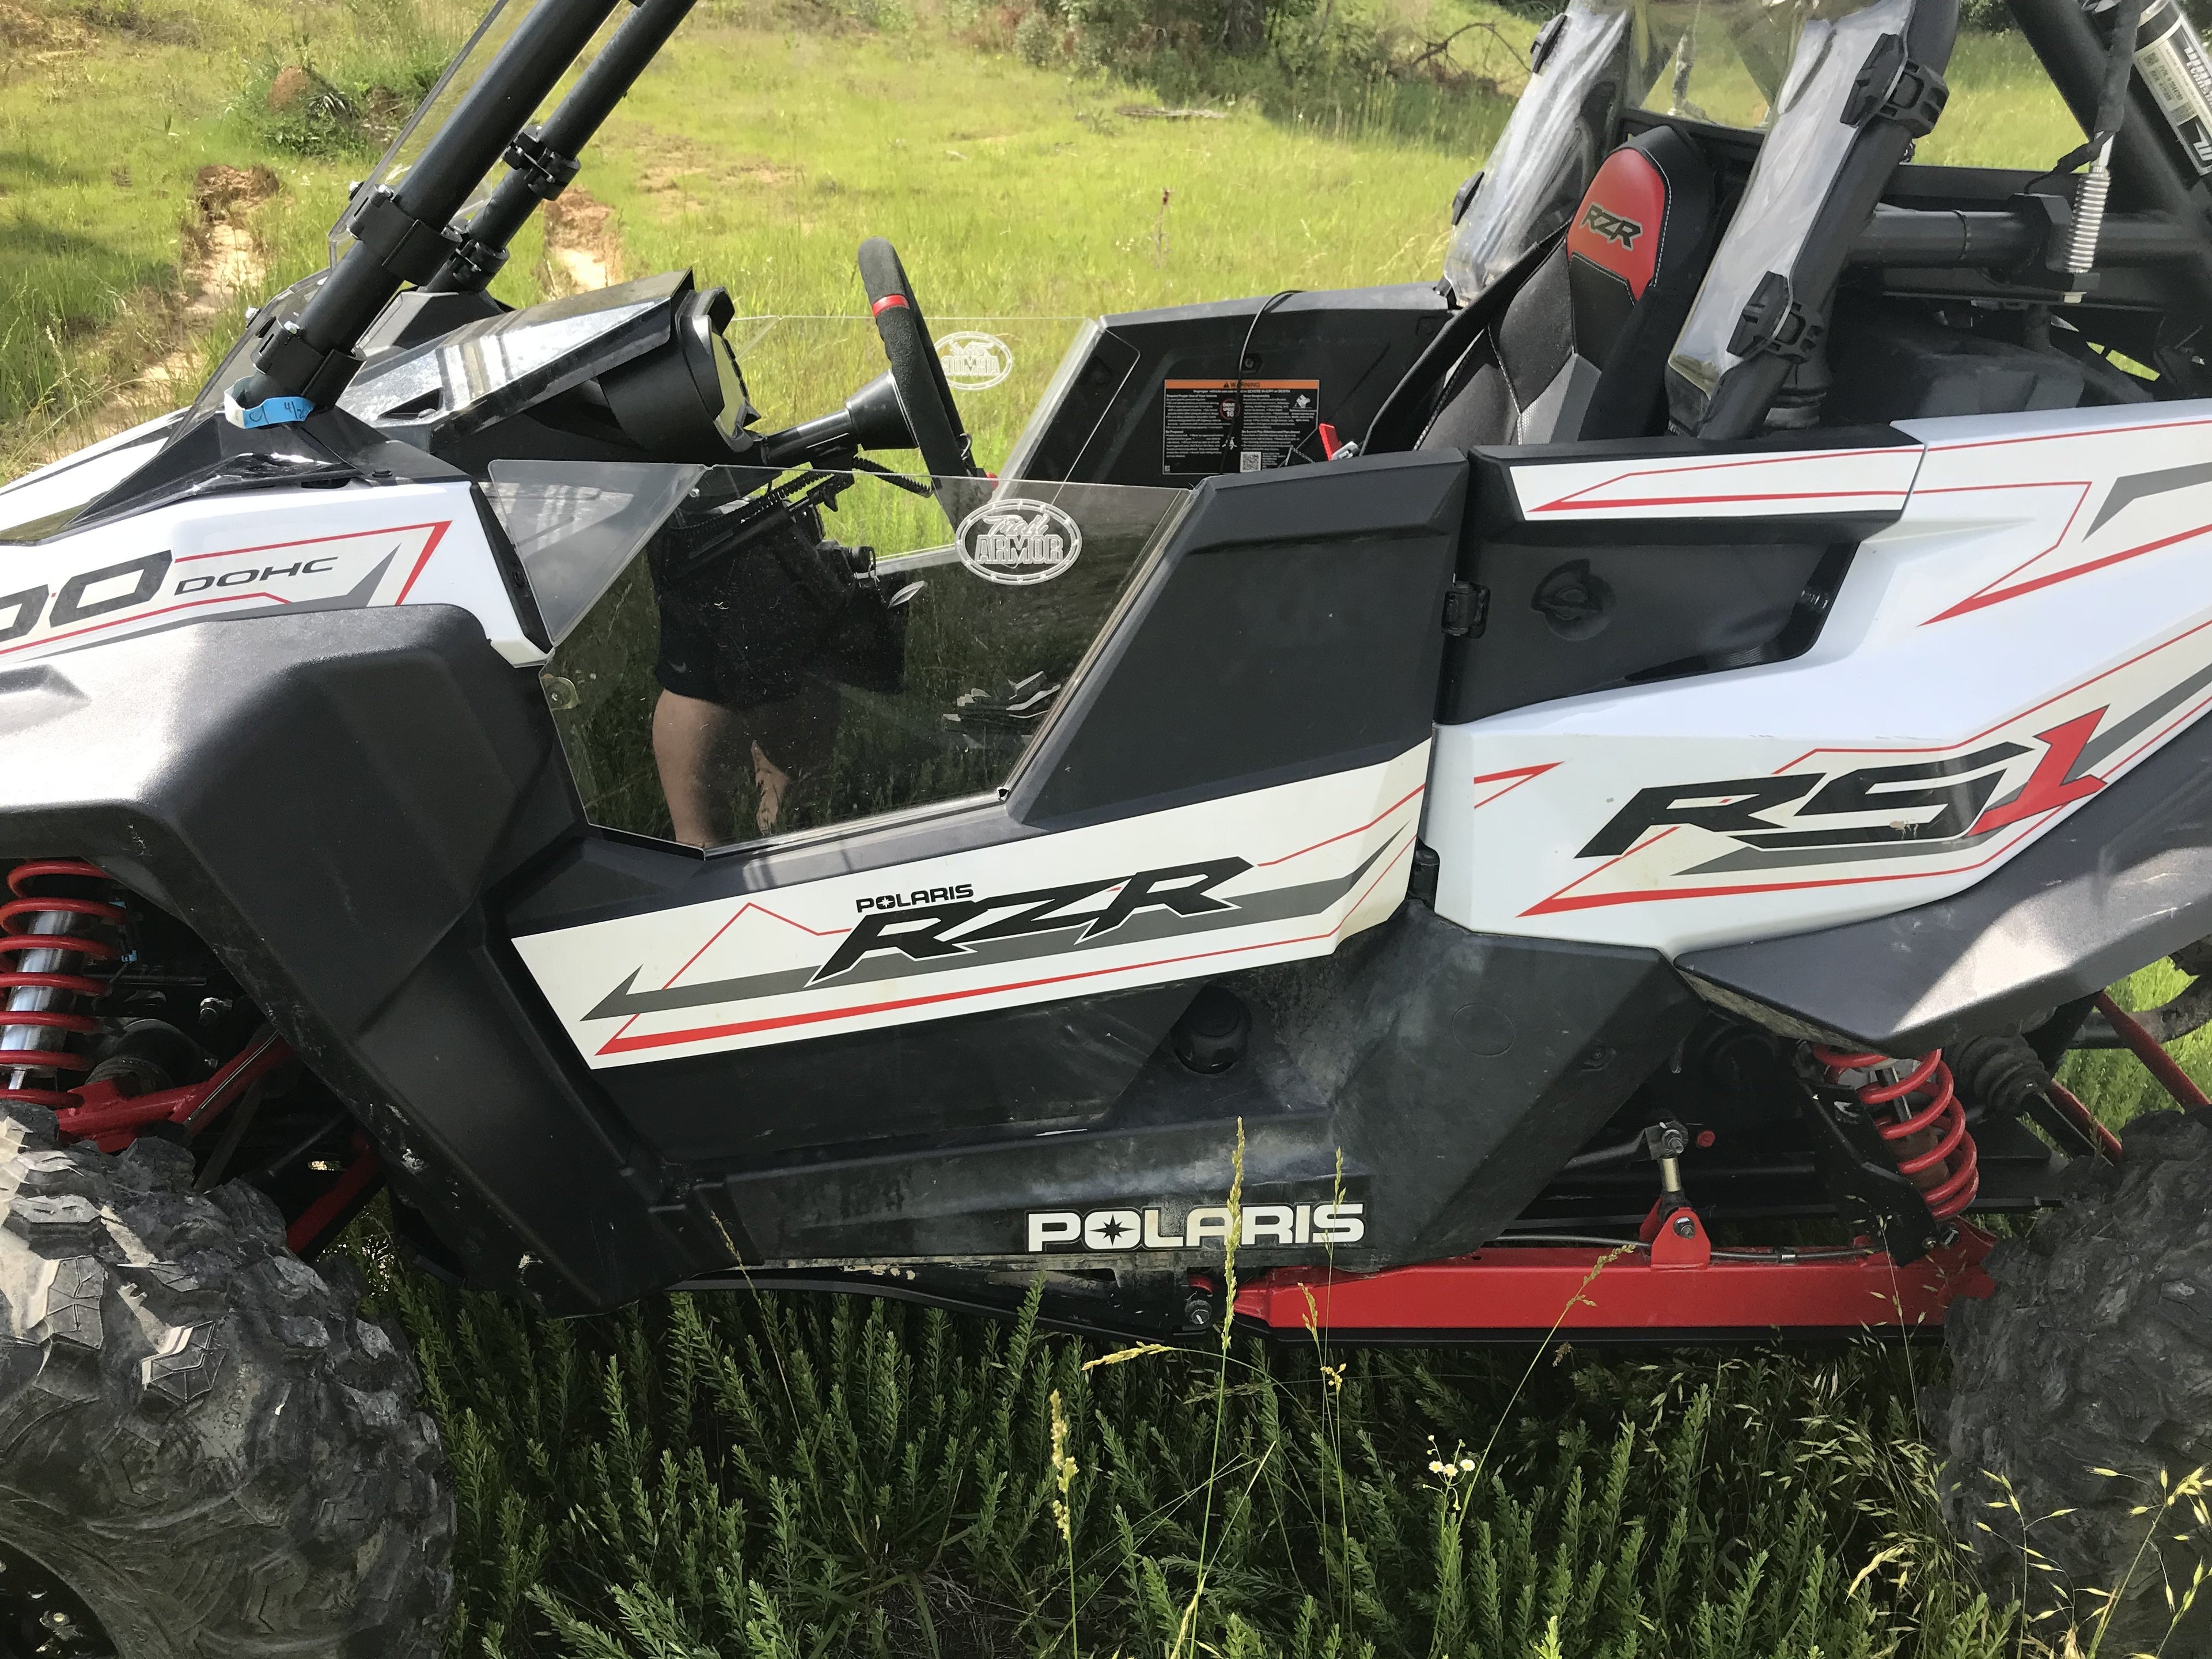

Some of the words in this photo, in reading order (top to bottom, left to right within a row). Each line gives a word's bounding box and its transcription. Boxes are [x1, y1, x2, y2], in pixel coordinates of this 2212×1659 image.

[1579, 203, 1643, 251] RZR
[983, 514, 1051, 536] Trail
[975, 535, 1063, 564] ARMOR
[174, 556, 339, 596] DOHC
[1573, 704, 2108, 858] RS1
[856, 884, 974, 913] POLARIS
[806, 857, 1255, 987] RZR
[1028, 1204, 1365, 1252] POLARIS
